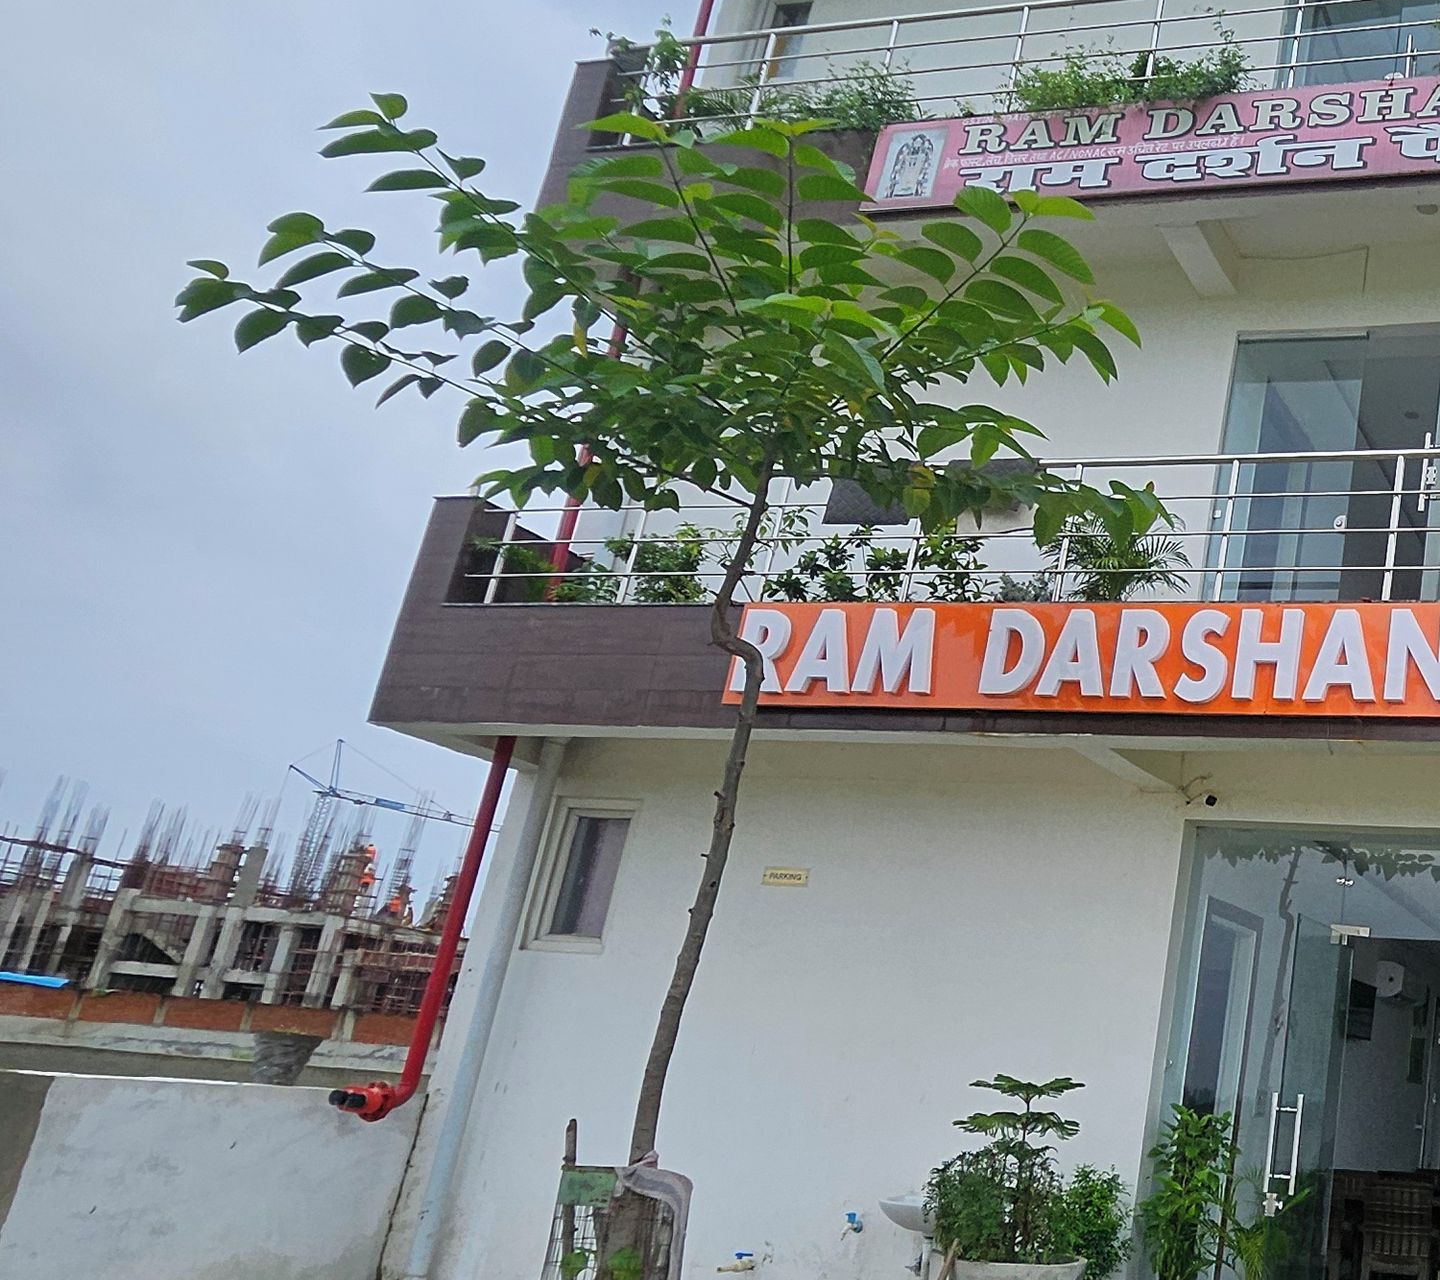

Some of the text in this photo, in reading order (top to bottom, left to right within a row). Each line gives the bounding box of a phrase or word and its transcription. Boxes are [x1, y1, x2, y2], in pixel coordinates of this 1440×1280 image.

[959, 112, 1125, 155] RAM
[959, 156, 1123, 194] राम
[1134, 134, 1377, 182] दर्शन
[729, 607, 936, 694] RAM
